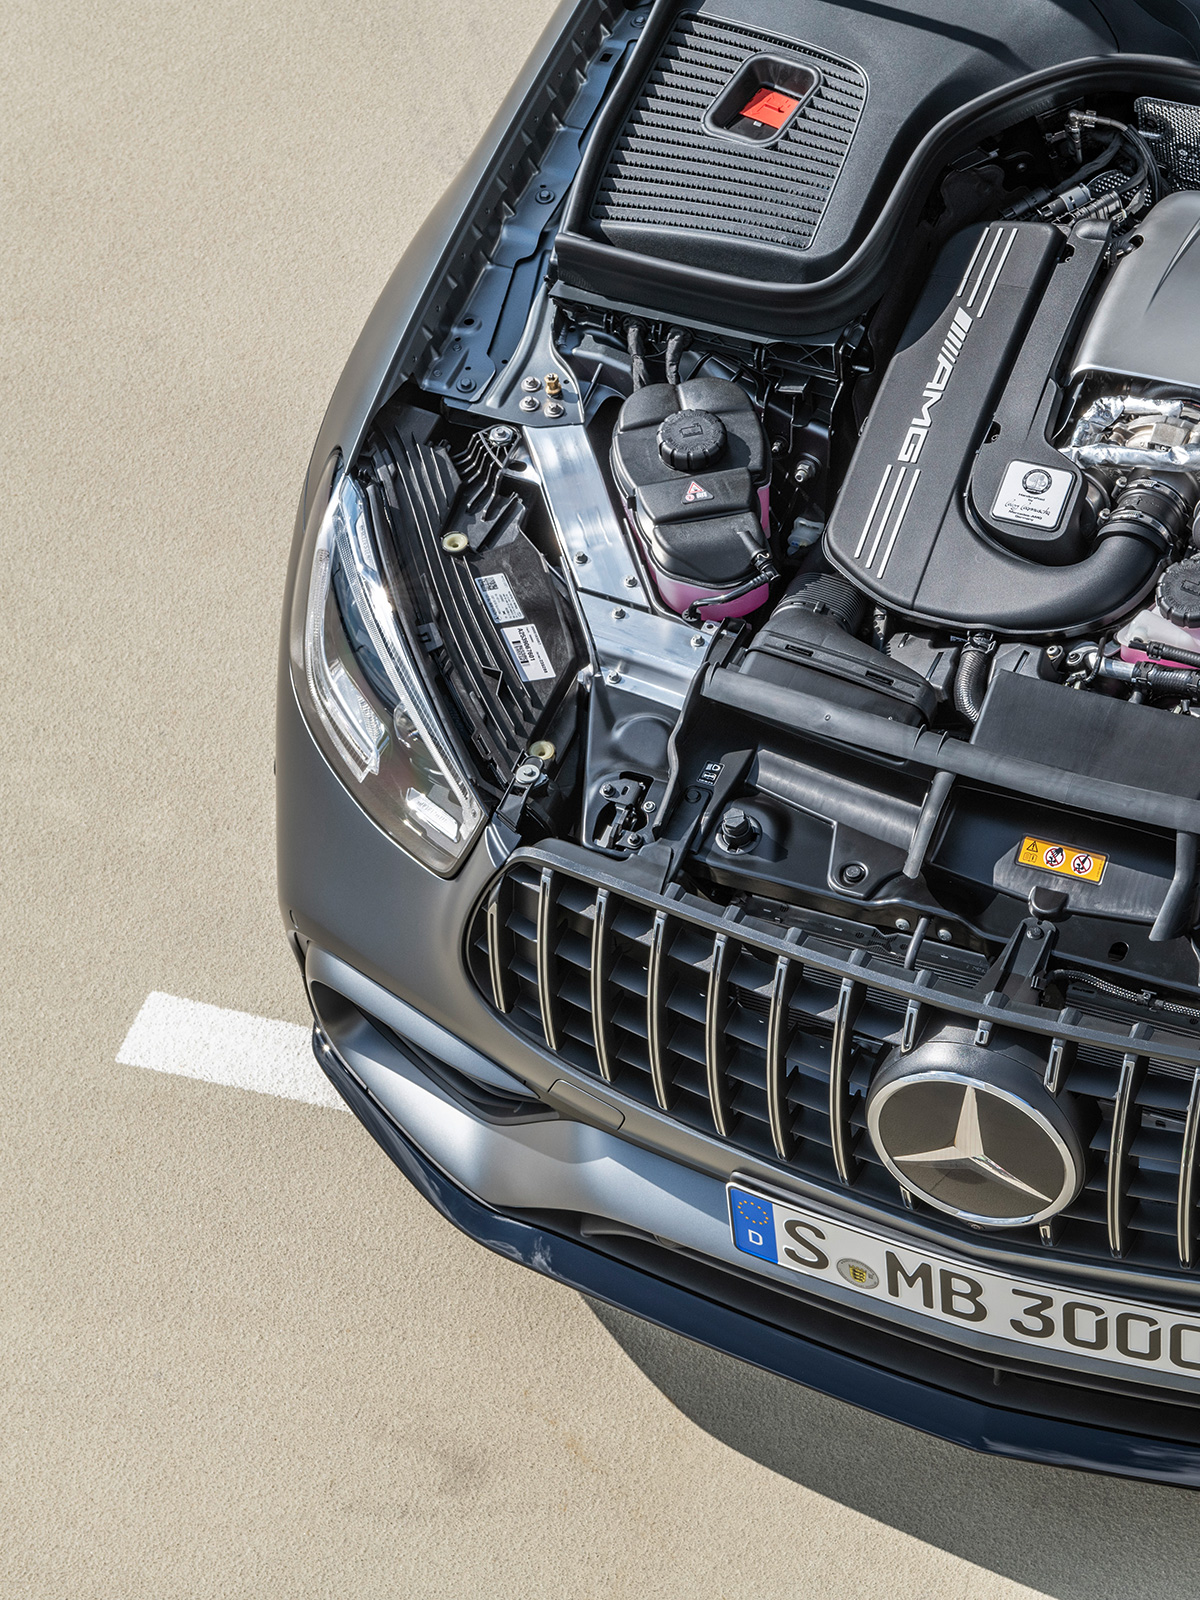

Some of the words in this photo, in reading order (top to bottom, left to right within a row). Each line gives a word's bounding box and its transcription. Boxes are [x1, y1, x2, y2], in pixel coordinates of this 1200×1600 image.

[897, 353, 954, 464] AMG
[748, 1229, 764, 1246] D
[783, 1218, 830, 1271] S
[884, 1249, 989, 1323] MB
